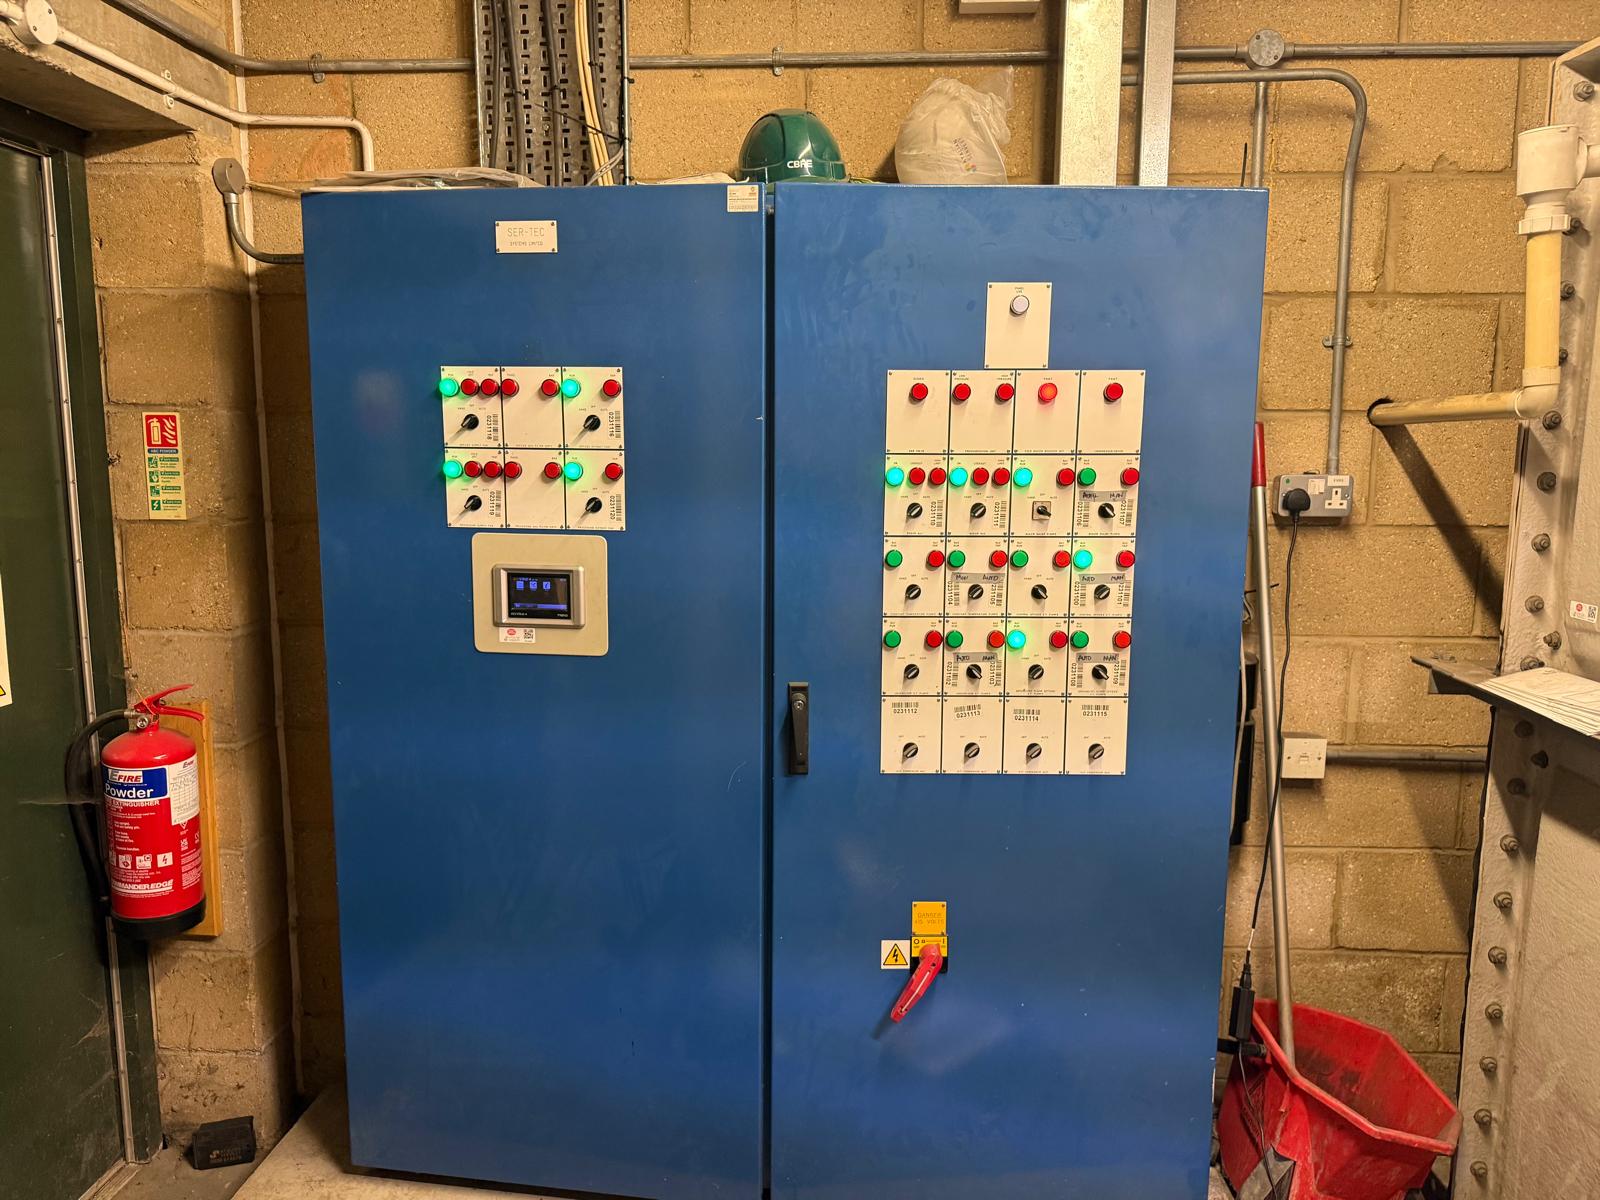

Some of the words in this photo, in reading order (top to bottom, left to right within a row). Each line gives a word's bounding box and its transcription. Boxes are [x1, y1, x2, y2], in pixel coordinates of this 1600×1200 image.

[786, 158, 813, 169] CBRE
[507, 227, 545, 237] SER-TEC
[956, 711, 981, 719] 0231113
[105, 783, 154, 798] Powder
[112, 799, 160, 807] EXTINGUISHER
[150, 878, 174, 889] EDGE
